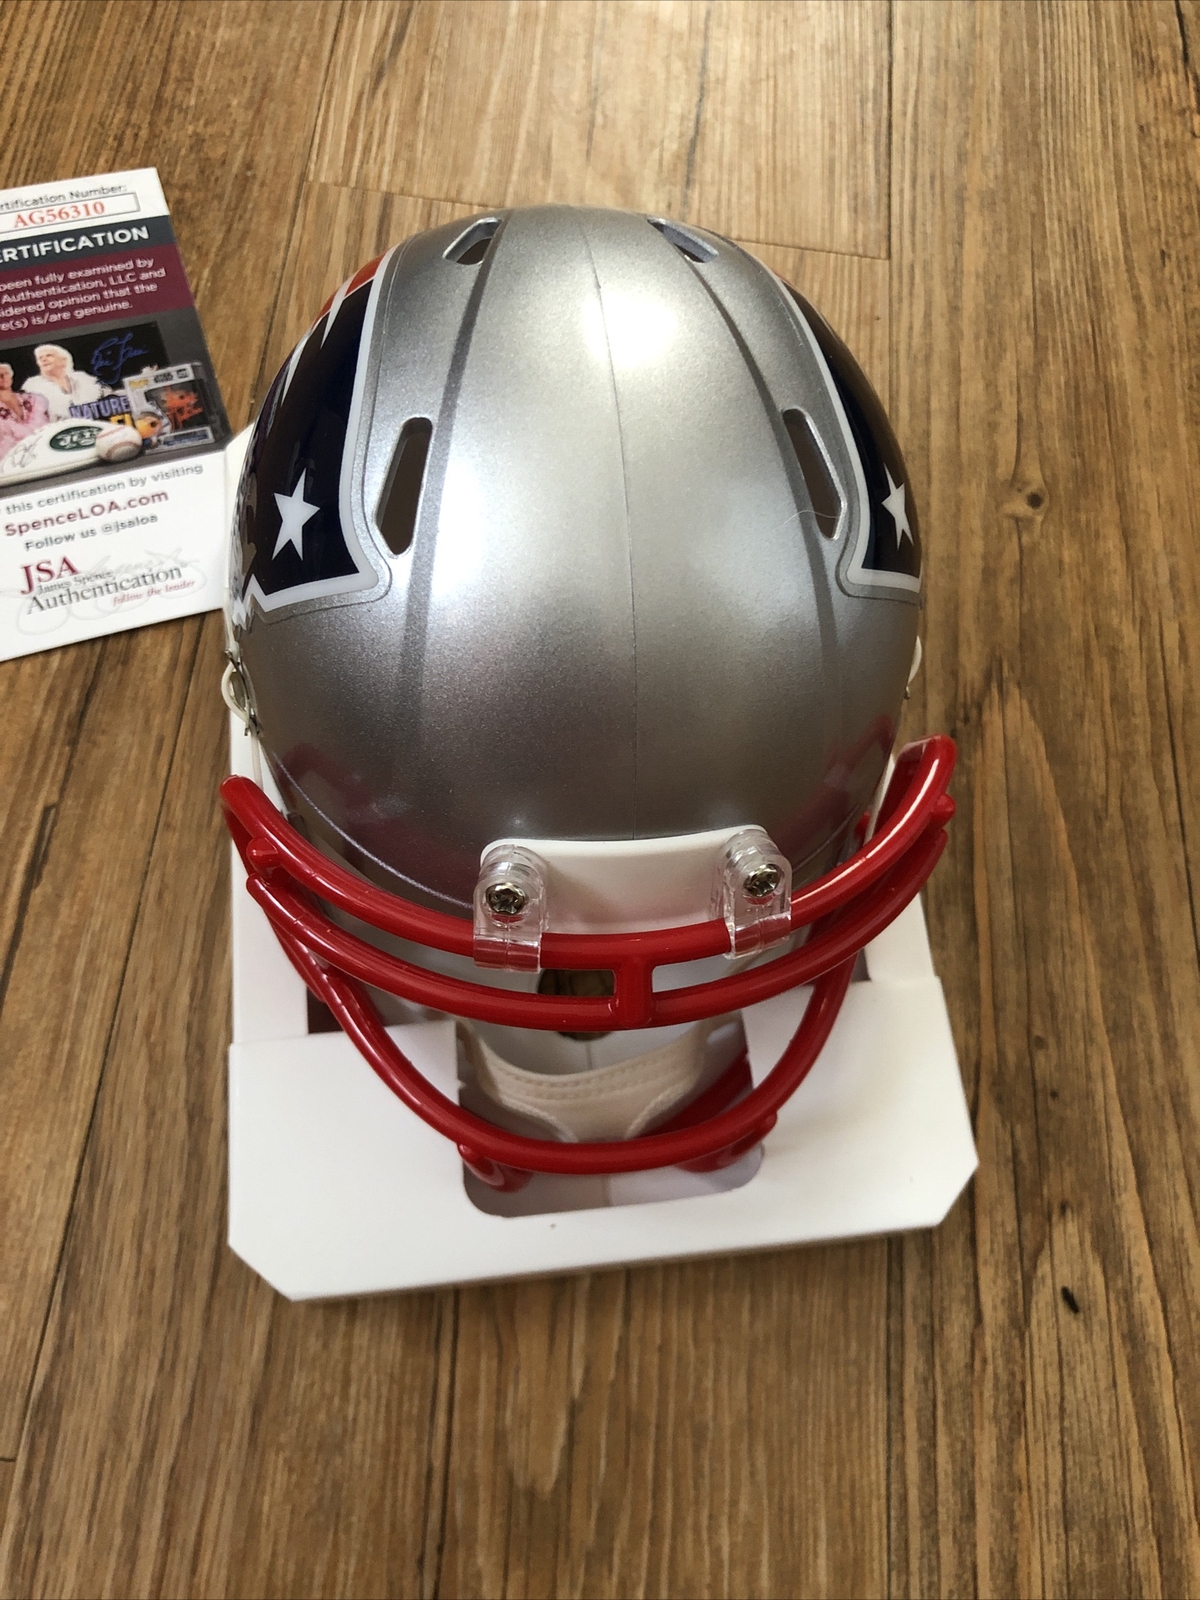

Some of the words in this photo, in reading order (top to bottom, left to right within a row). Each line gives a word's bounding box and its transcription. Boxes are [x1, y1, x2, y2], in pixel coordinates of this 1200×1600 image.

[70, 185, 128, 200] Number:
[13, 201, 105, 228] AG56310
[2, 278, 107, 304] Authentication,
[109, 274, 137, 286] LLC
[139, 268, 166, 281] and
[34, 271, 65, 286] fully
[68, 261, 134, 280] examined
[135, 258, 154, 270] by
[48, 292, 101, 310] opinion
[103, 287, 132, 300] that
[135, 282, 157, 294] the
[31, 310, 71, 326] is/are
[74, 300, 133, 319] genuine.
[70, 398, 131, 419] NATURE
[6, 500, 33, 515] this
[38, 481, 125, 508] certification
[130, 475, 147, 488] by
[151, 463, 204, 481] visiting
[5, 490, 169, 537] SpenceLOA.com
[25, 531, 75, 551] Follow
[81, 528, 97, 538] us
[101, 514, 158, 533] @jsaloa
[20, 556, 81, 596] JSA
[112, 592, 144, 607] follow
[147, 588, 162, 598] the
[165, 580, 196, 593] leader
